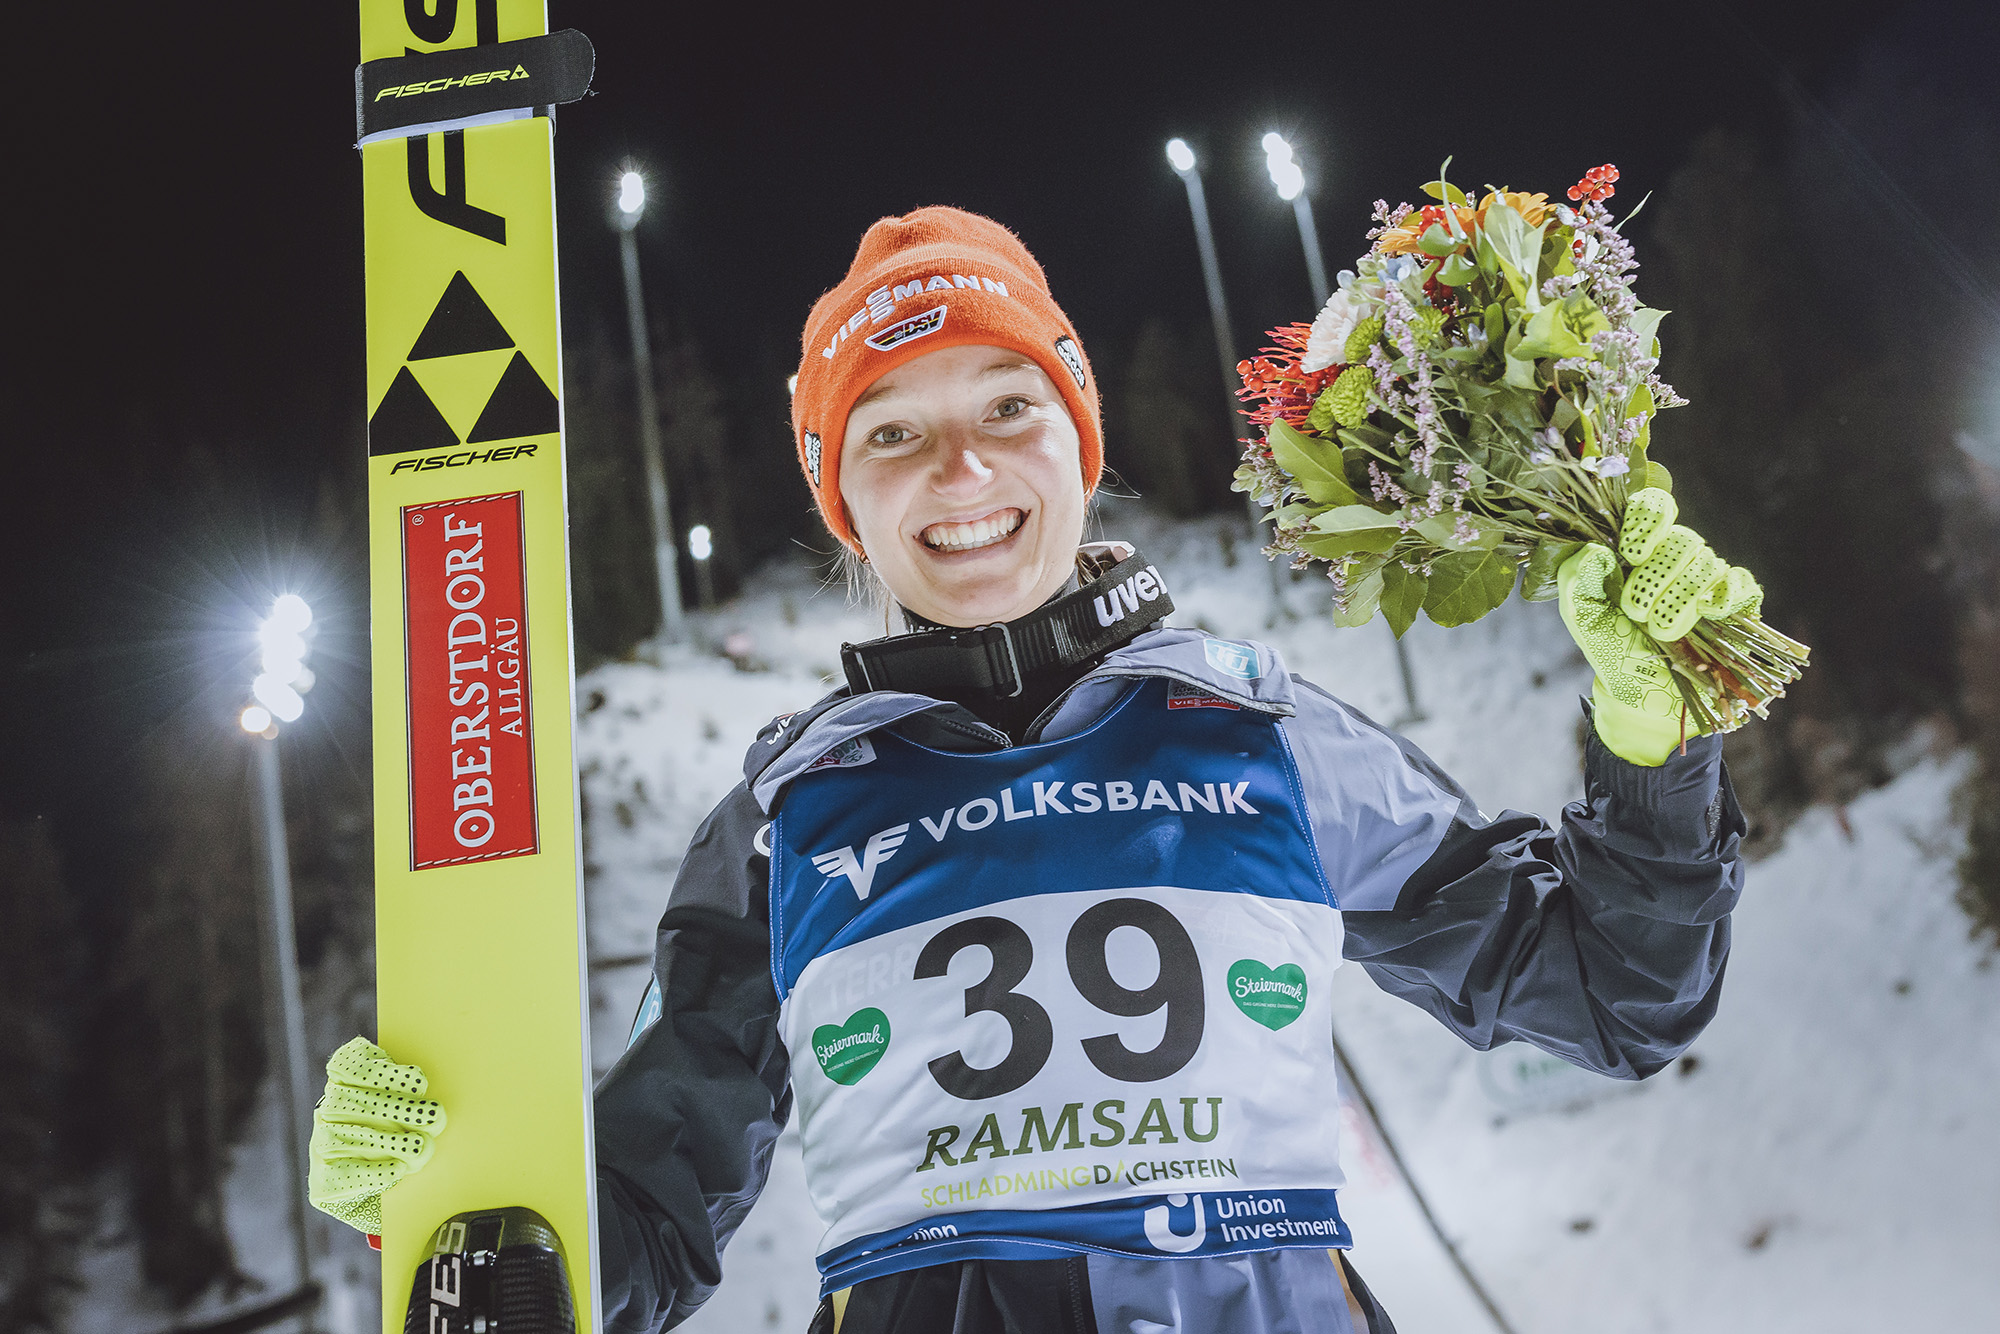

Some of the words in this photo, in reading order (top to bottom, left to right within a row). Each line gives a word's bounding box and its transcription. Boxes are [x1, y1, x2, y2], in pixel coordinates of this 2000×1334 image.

[374, 67, 512, 102] FISCHER
[822, 274, 1010, 360] VIESSMANN
[390, 443, 538, 476] FISCHER
[444, 512, 496, 849] OBERSTDORF
[489, 616, 523, 738] ALLGÄU
[1635, 665, 1658, 679] SEIZ
[918, 780, 1260, 843] VOLKSBANK
[912, 898, 1206, 1101] 39
[1235, 976, 1304, 1003] Steiermark
[816, 1024, 885, 1066] Steiermark
[916, 1096, 1223, 1173] RAMSAU
[1216, 1194, 1287, 1219] Union
[907, 1224, 959, 1241] nion
[1220, 1216, 1340, 1243] Investment
